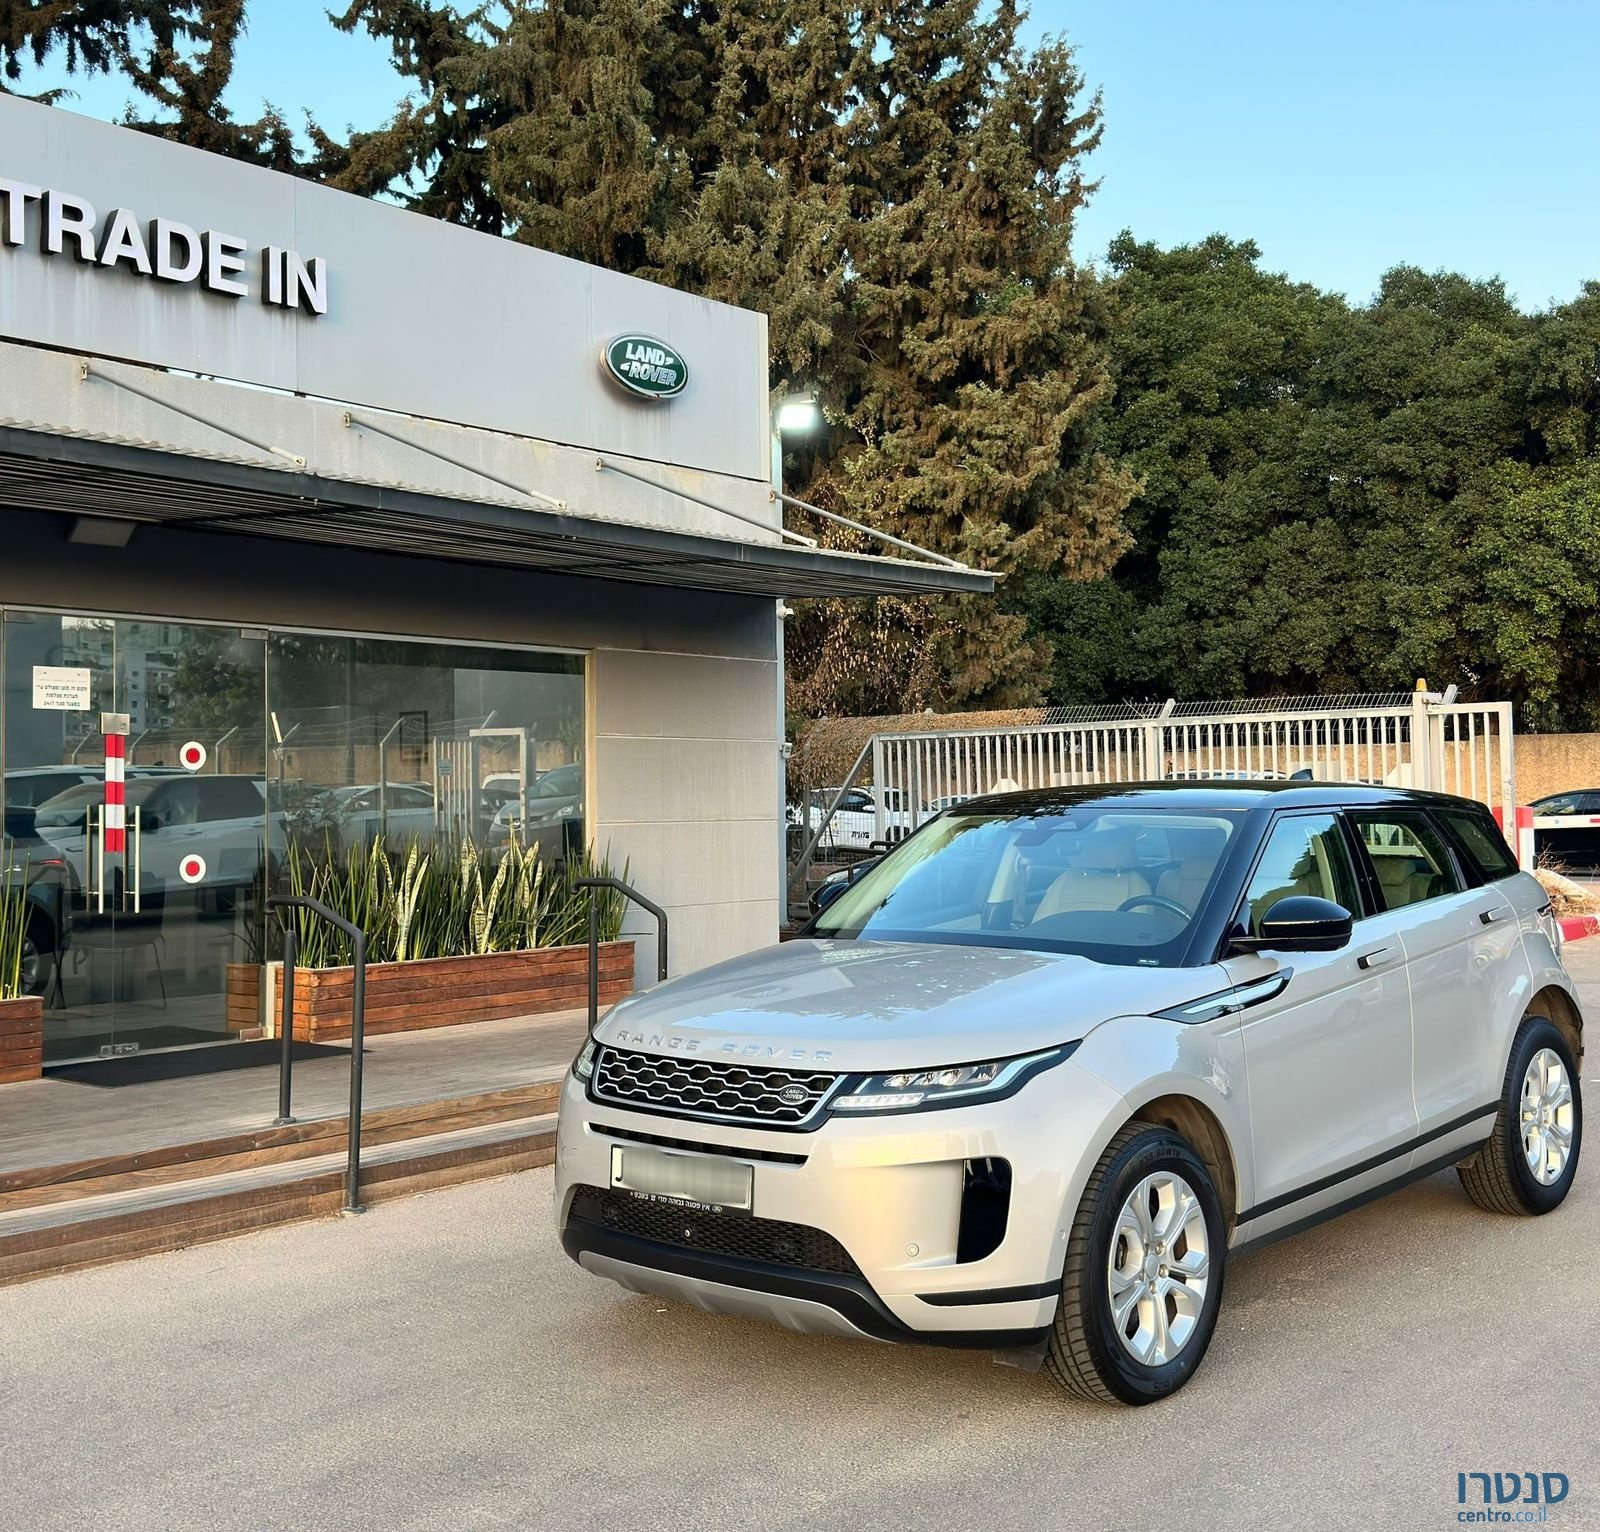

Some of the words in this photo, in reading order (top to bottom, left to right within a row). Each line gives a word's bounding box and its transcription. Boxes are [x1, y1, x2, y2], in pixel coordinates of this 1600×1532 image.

[0, 178, 248, 298] TRADE
[262, 245, 327, 316] IN
[625, 342, 665, 366] LAND
[628, 360, 677, 387] ROVER
[616, 1030, 702, 1052] RANGE
[720, 1042, 833, 1063] ROVER
